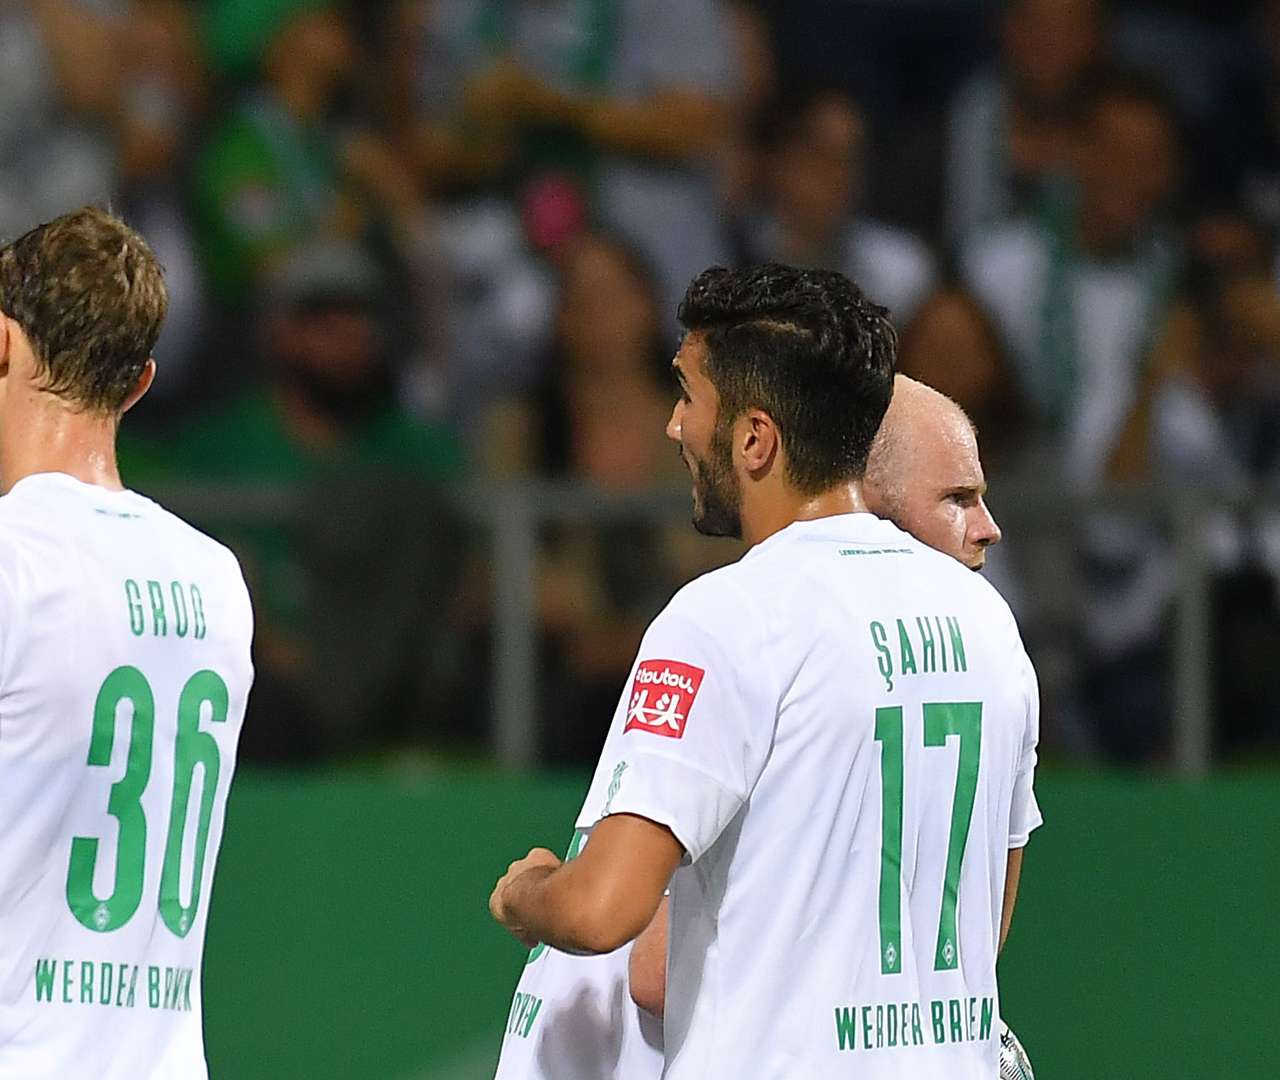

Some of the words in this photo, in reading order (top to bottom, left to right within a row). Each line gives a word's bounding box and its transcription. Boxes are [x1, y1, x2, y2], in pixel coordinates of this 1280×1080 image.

[869, 615, 968, 692] ŞAHIN
[65, 665, 229, 939] 36
[874, 701, 984, 975] 17
[35, 958, 139, 1008] WERDER
[835, 1003, 924, 1051] WERDER
